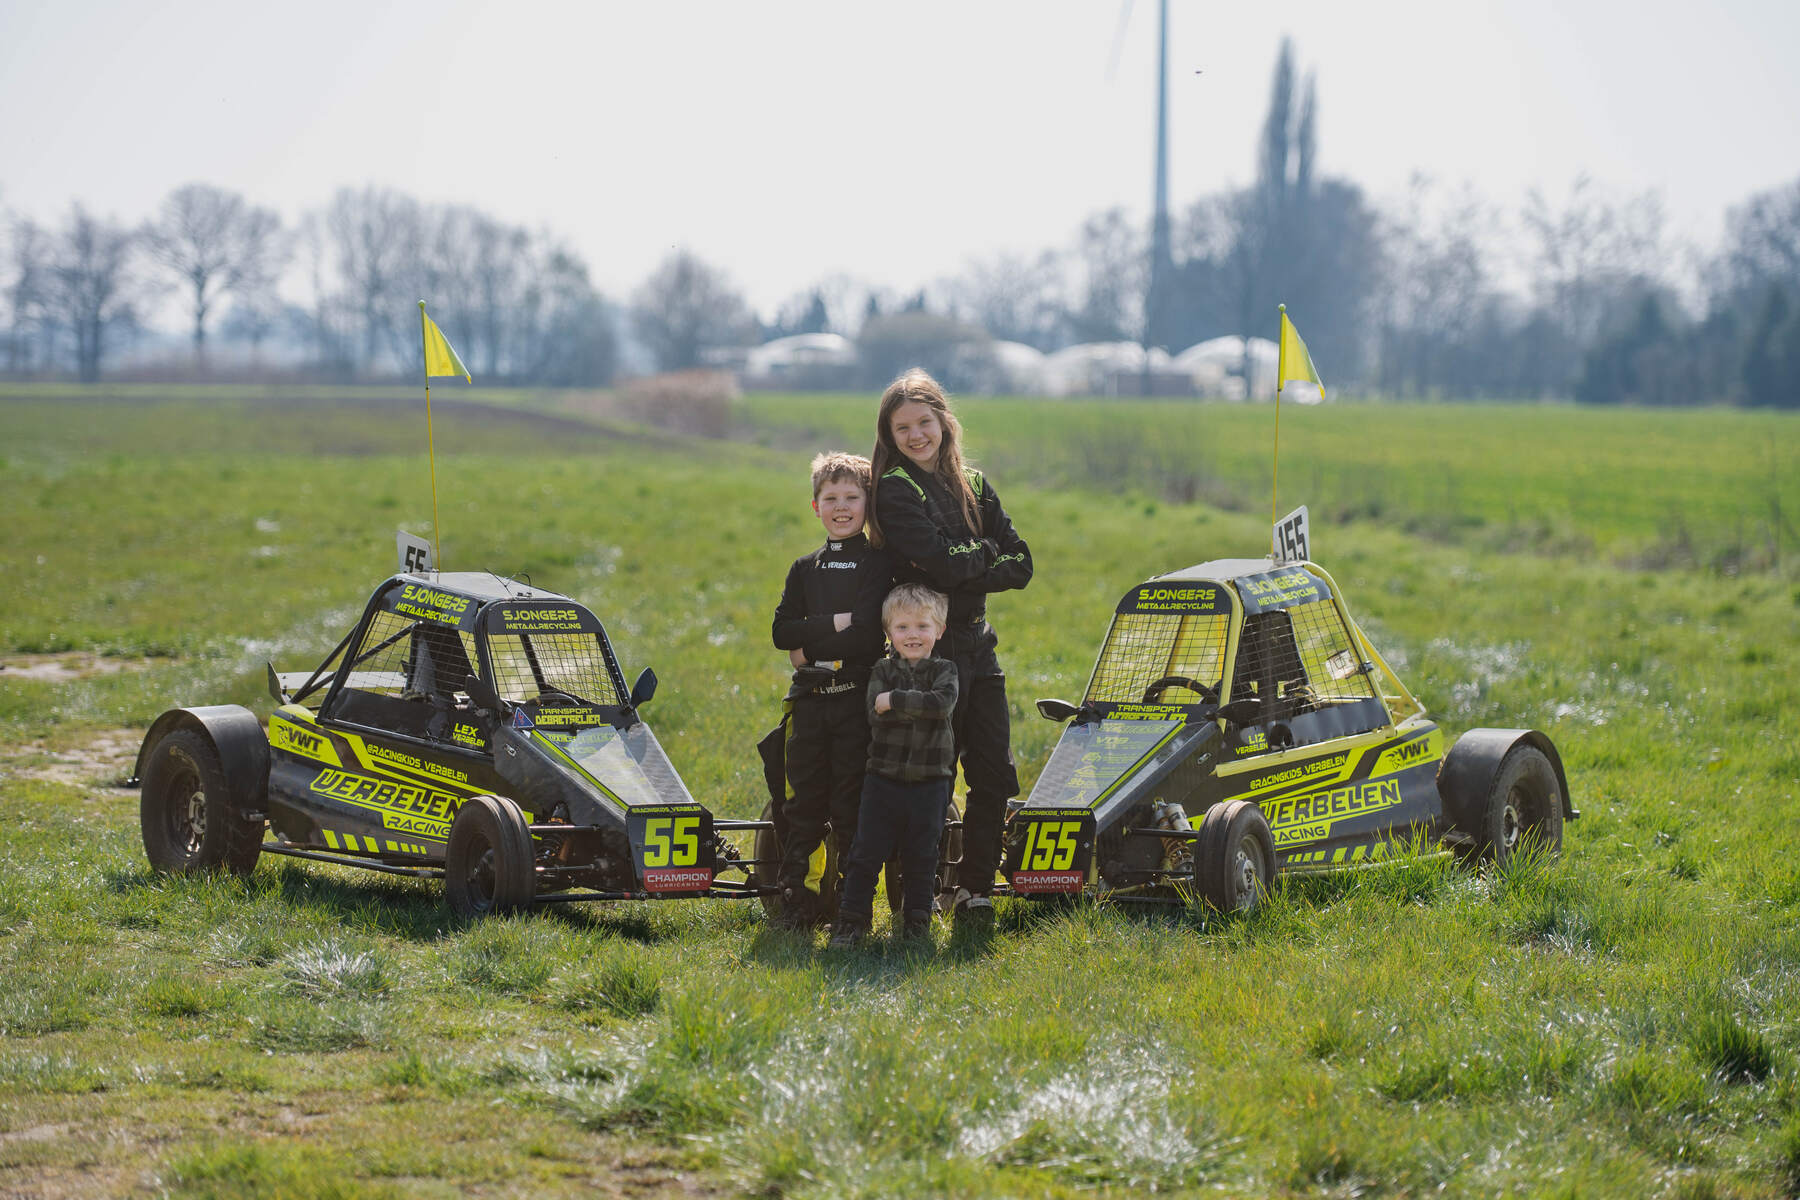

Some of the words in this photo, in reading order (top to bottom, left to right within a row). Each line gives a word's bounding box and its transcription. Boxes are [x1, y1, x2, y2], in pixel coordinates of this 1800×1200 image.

[1279, 515, 1308, 561] 155
[405, 545, 426, 572] 55
[1138, 589, 1216, 600] SJONGERS
[1244, 573, 1310, 595] SJONGERS
[401, 585, 470, 612] SJONGERS
[1136, 602, 1215, 610] METAALRECYCLING
[395, 602, 461, 625] METAALRECYCLING
[502, 610, 578, 621] SJONGERS
[1117, 704, 1183, 713] TRANSPORT
[288, 727, 323, 752] VWT
[452, 732, 486, 747] VERBELEN
[454, 723, 479, 736] LEX
[1248, 733, 1266, 744] LIZ
[1235, 742, 1268, 754] VERBELEN
[1398, 737, 1430, 760] VWT
[367, 744, 467, 783] @RACINGKIDS_VERBELEN
[1250, 755, 1345, 790] @RACINGKIDS_VERBELEN
[310, 768, 467, 824] VERBELEN
[1261, 779, 1402, 829] VERBELEN
[387, 817, 450, 836] RACING
[644, 817, 700, 867] 55
[1020, 822, 1082, 871] 155
[647, 873, 708, 883] CHAMPION
[1015, 876, 1079, 884] CHAMPION
